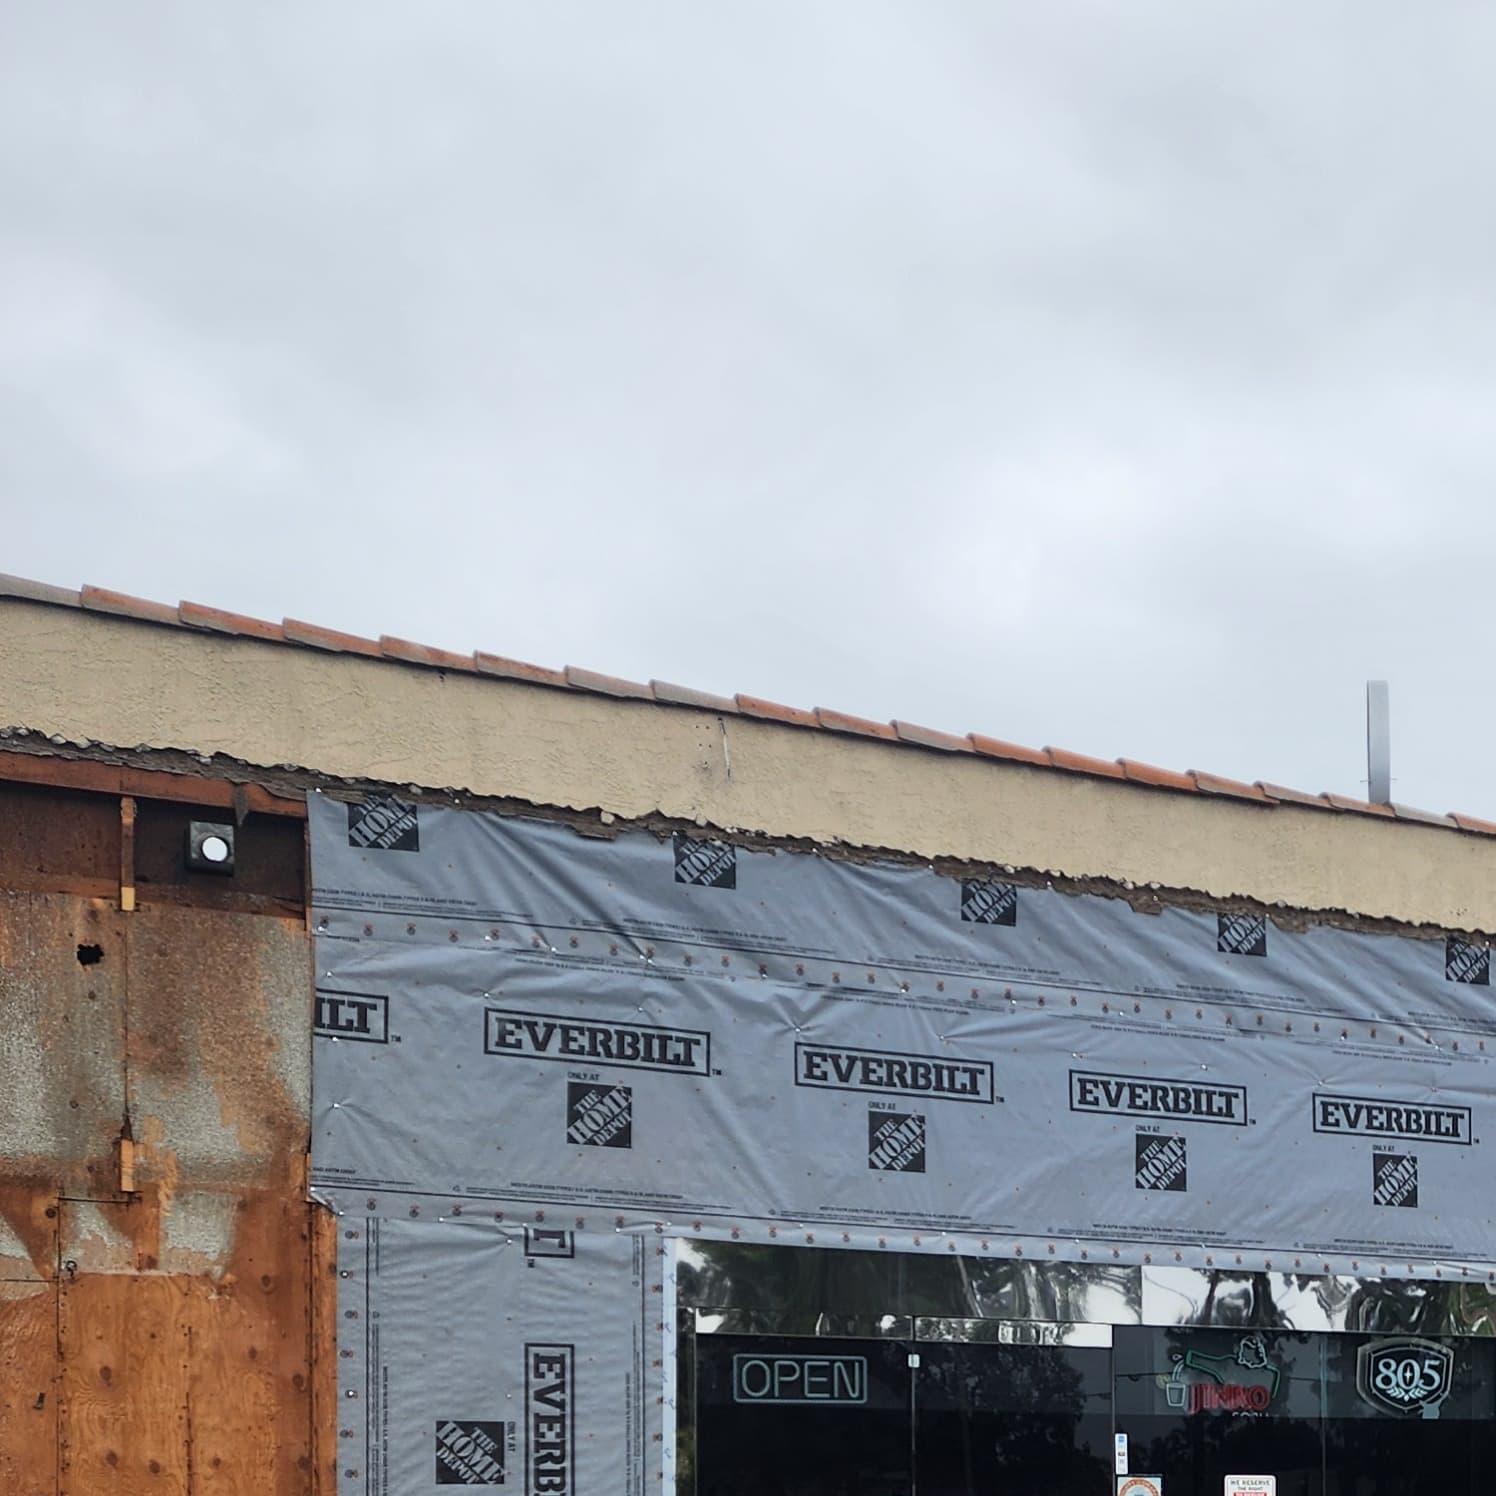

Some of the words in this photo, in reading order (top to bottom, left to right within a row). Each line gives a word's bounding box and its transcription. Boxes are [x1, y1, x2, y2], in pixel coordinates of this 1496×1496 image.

[700, 854, 735, 886] DEPOT
[495, 1017, 701, 1067] EVERBILT
[803, 1050, 985, 1096] EVERBILT
[568, 1087, 632, 1143] HOME
[573, 1090, 601, 1113] THE
[1079, 1078, 1239, 1119] EVERBILT
[593, 1109, 632, 1145] DEPOT
[874, 1119, 898, 1140] THE
[1320, 1100, 1464, 1138] EVERBILT
[869, 1116, 925, 1169] HOME
[891, 1137, 925, 1170] DEPOT
[1140, 1141, 1162, 1162] THE
[1136, 1138, 1186, 1189] HOME
[1156, 1158, 1186, 1190] DEPOT
[1373, 1157, 1417, 1204] HOME
[1377, 1160, 1396, 1179] THE
[1391, 1176, 1417, 1206] DEPOT
[741, 1360, 861, 1398] OPEN
[1376, 1358, 1441, 1391] 805
[436, 1421, 505, 1484] HOME
[471, 1426, 498, 1453] THE
[436, 1445, 482, 1484] DEPOT
